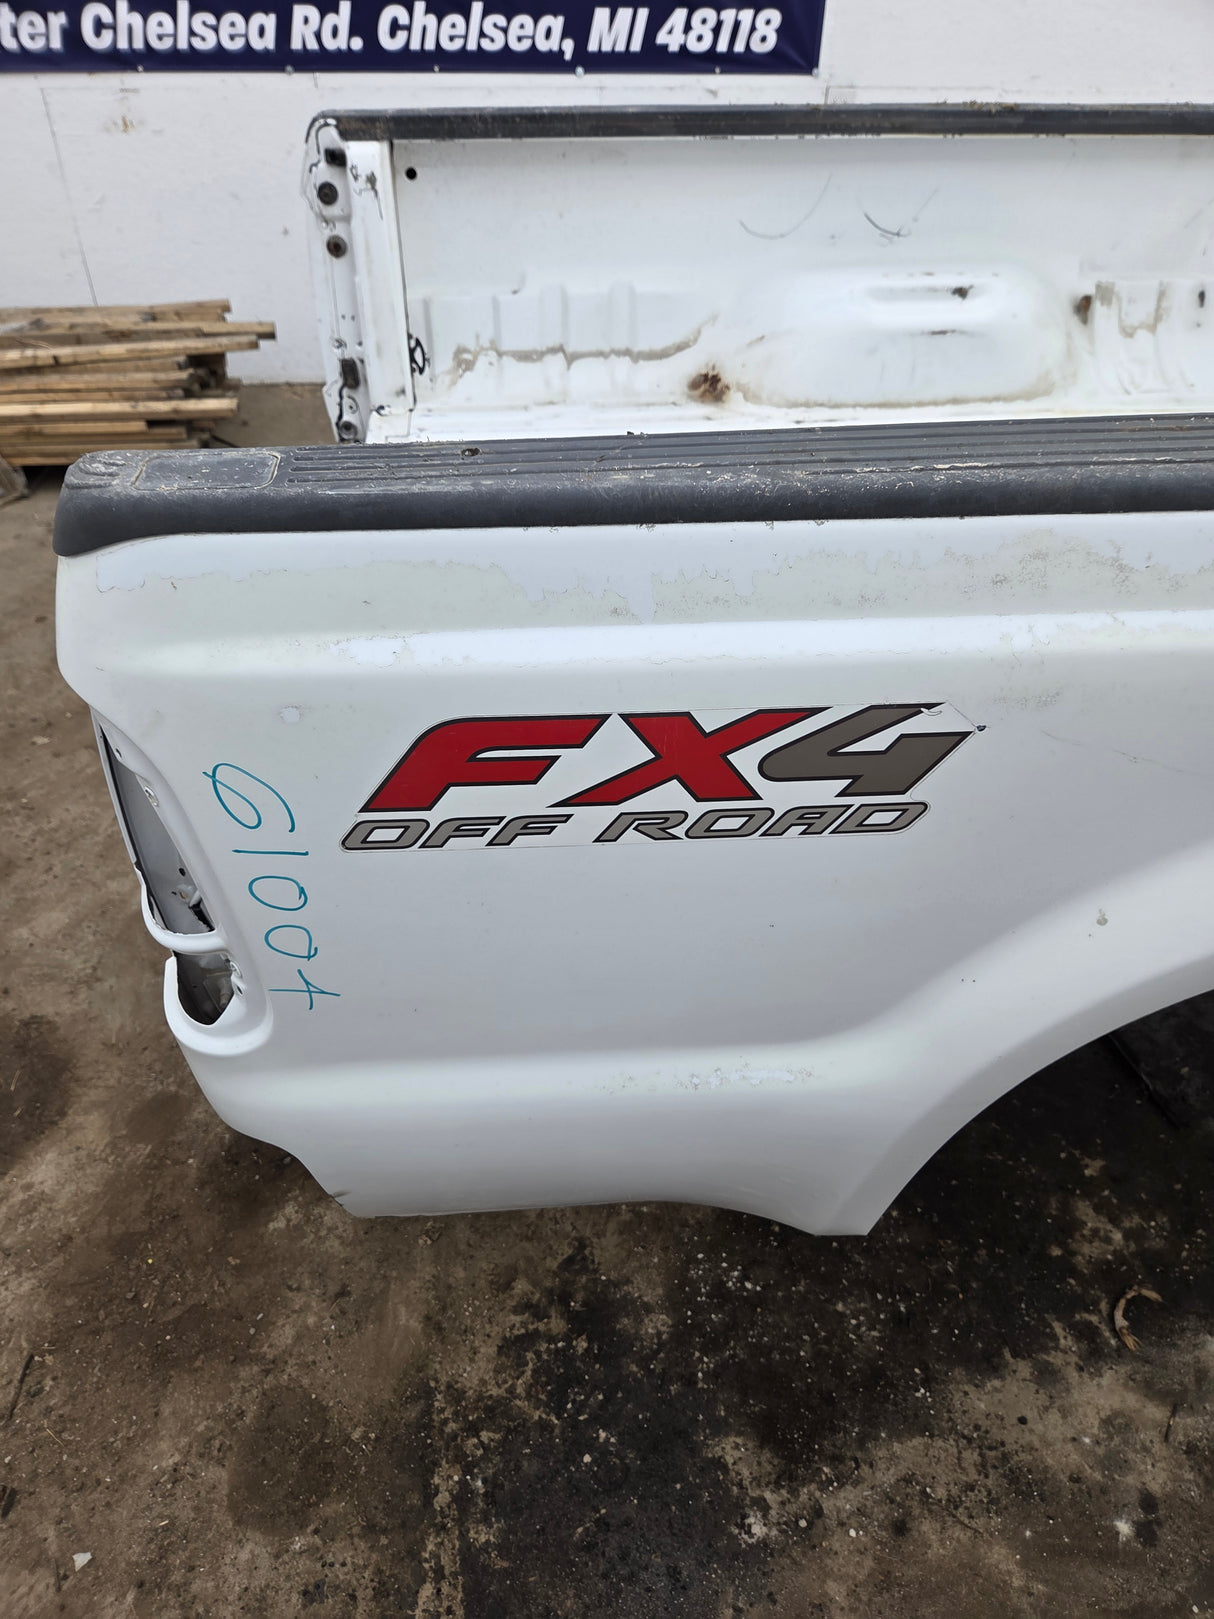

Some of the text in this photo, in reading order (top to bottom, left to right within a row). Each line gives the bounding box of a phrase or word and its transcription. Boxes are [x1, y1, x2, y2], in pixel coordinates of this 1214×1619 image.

[81, 0, 276, 51] Chelsea
[290, 0, 364, 51] Rd.
[377, 0, 574, 60] Chelsea,
[587, 8, 649, 52] MI
[656, 8, 782, 53] 48118
[358, 702, 976, 813] FX4
[341, 801, 929, 850] OFF ROAD
